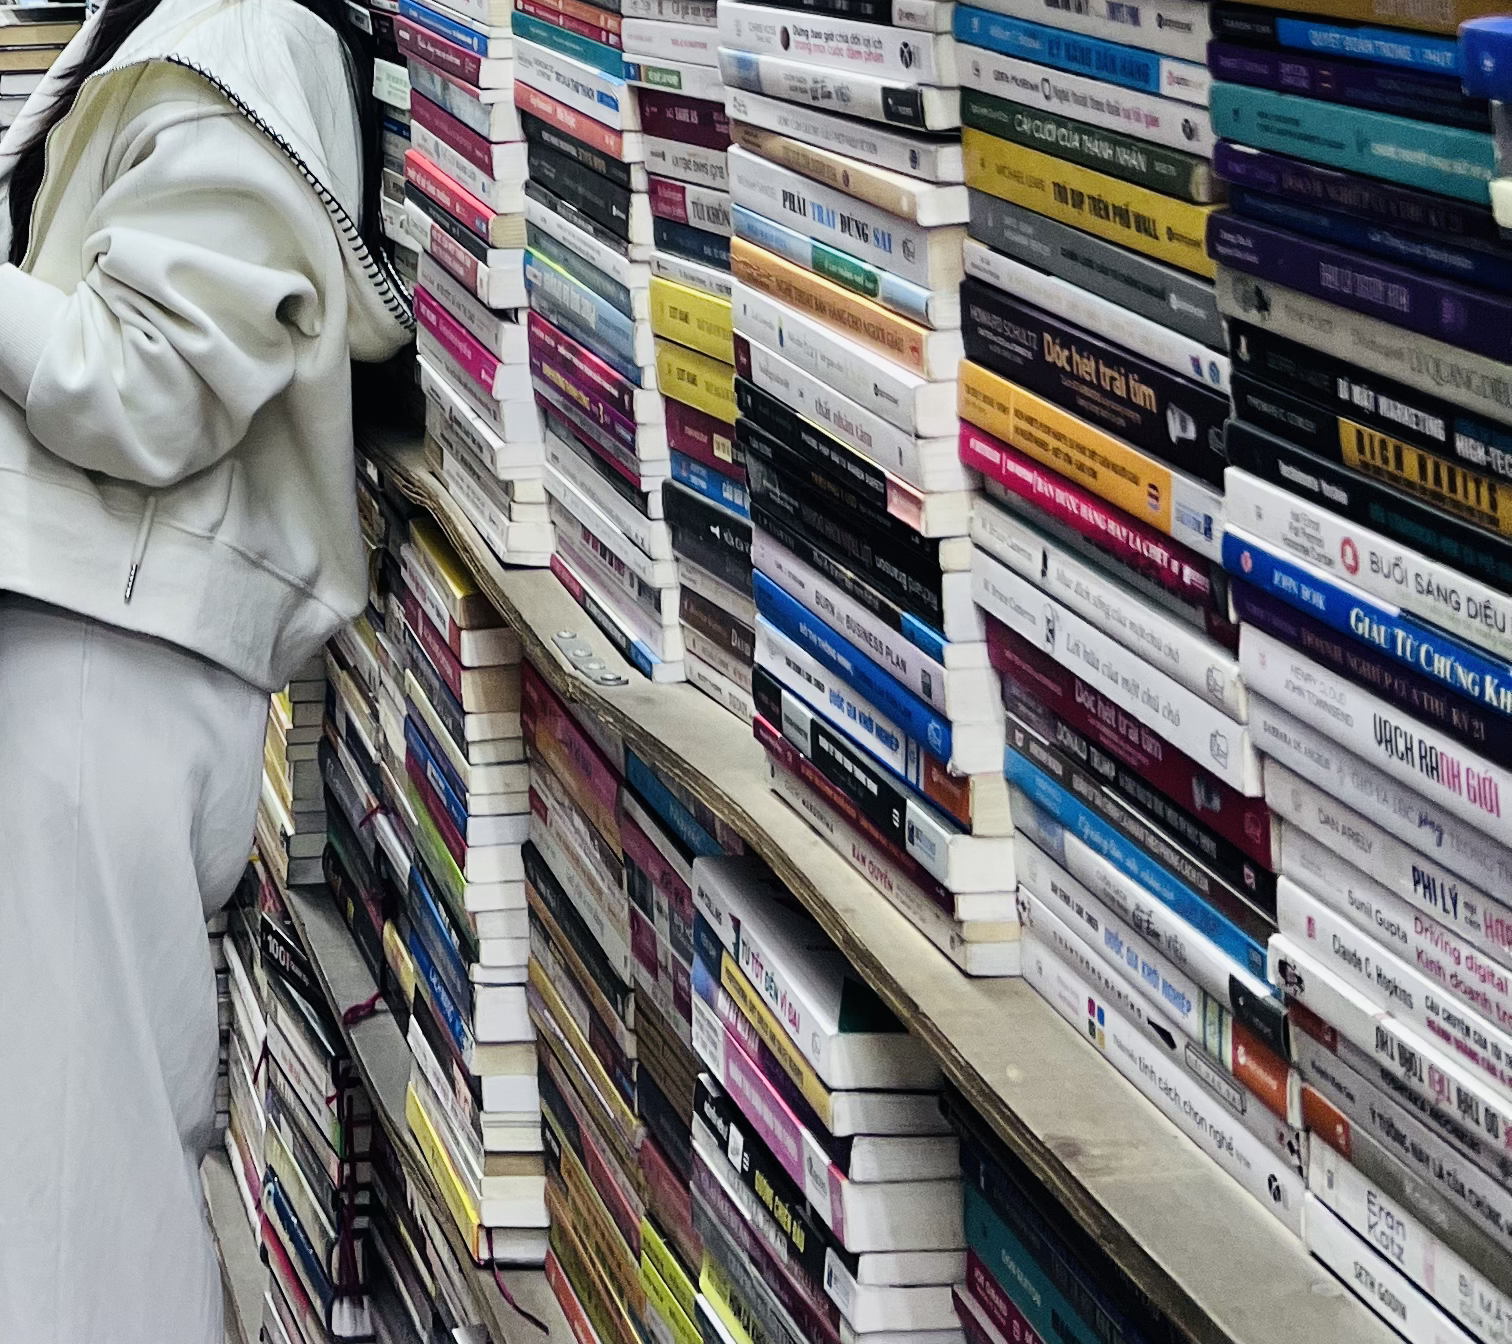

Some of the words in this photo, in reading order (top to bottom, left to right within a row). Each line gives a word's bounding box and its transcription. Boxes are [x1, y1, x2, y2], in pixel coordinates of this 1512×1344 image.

[781, 186, 811, 219] PHẢI
[813, 199, 842, 233] TRÁI
[843, 211, 872, 246] ĐÚNG
[875, 225, 892, 255] SAI
[1043, 330, 1068, 371] Dốc
[1071, 344, 1095, 383] hết
[1098, 357, 1123, 396] trái
[1370, 550, 1413, 591] BUỔI
[1420, 570, 1465, 614] SÁNG
[1471, 590, 1506, 633] DIỆU
[1374, 711, 1417, 769] VẠCH
[1421, 737, 1462, 796] RANH
[1348, 890, 1374, 921] Sunil
[1376, 907, 1408, 943] Gupta
[1412, 864, 1445, 907] PHI
[1448, 882, 1467, 921] LÝ
[1414, 914, 1463, 966] Driving
[1467, 949, 1508, 996] digital
[1164, 1078, 1193, 1120] cách
